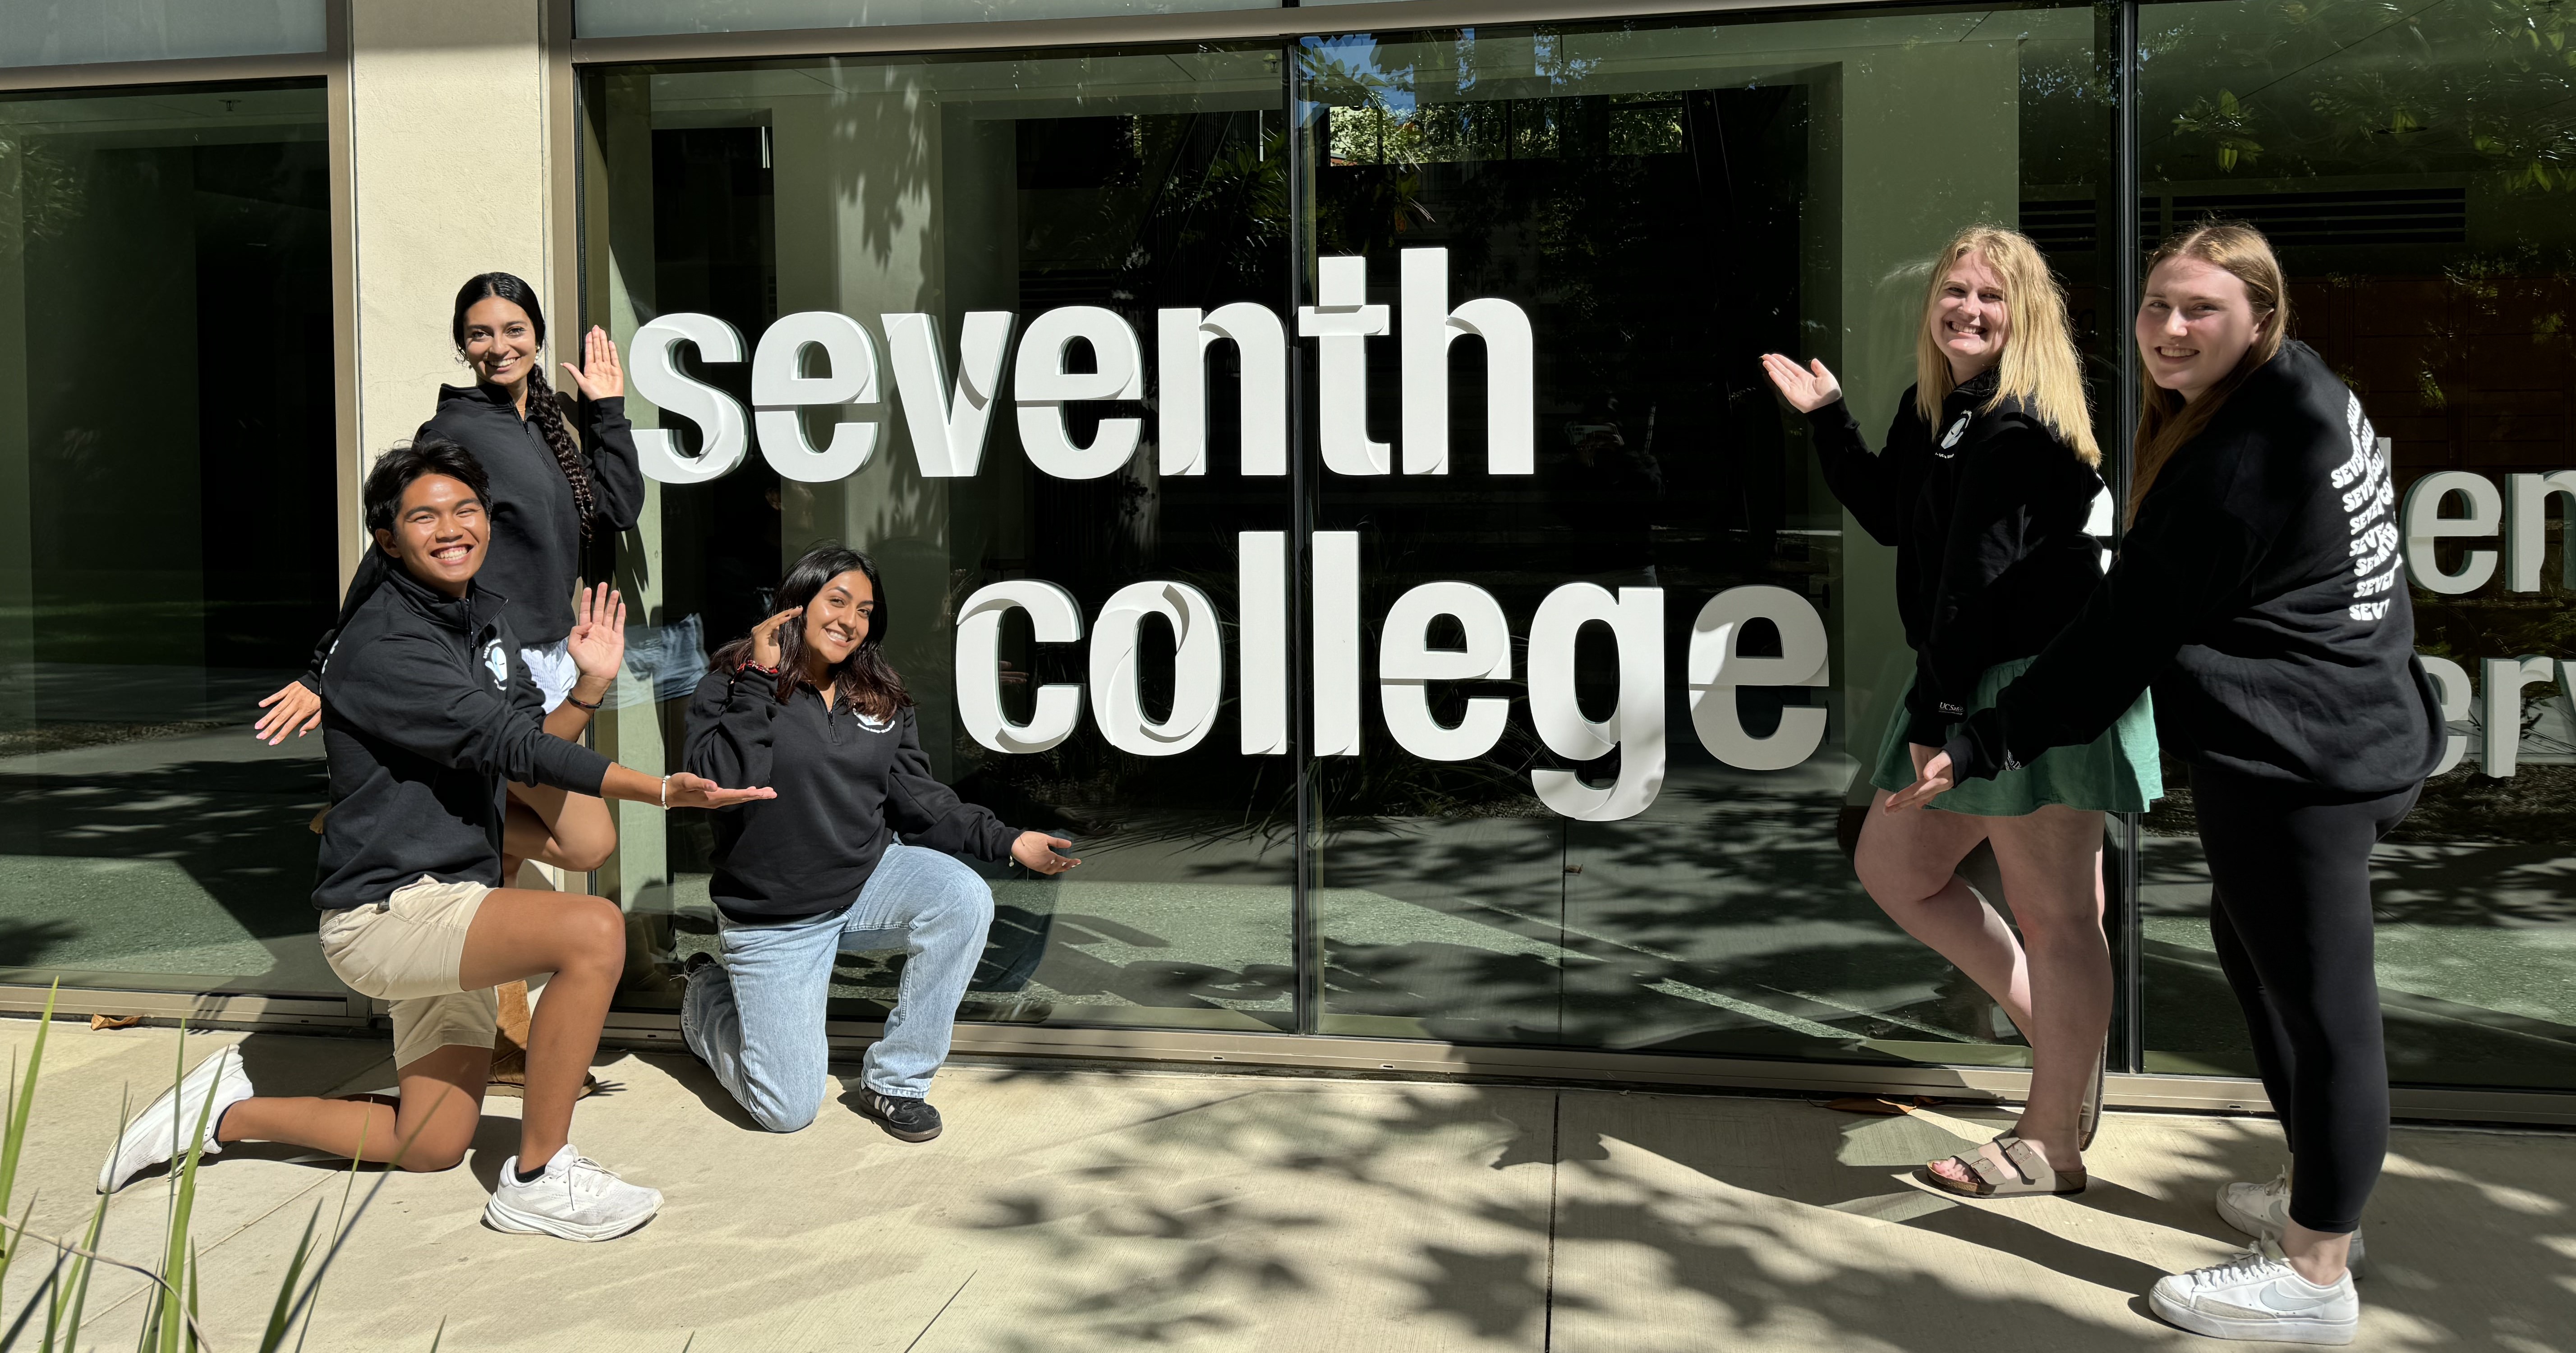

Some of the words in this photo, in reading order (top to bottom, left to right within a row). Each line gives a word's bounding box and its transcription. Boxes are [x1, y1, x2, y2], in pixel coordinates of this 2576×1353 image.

[629, 247, 1535, 484] seventh
[956, 530, 1830, 821] college
[1940, 702, 1950, 710] UC
